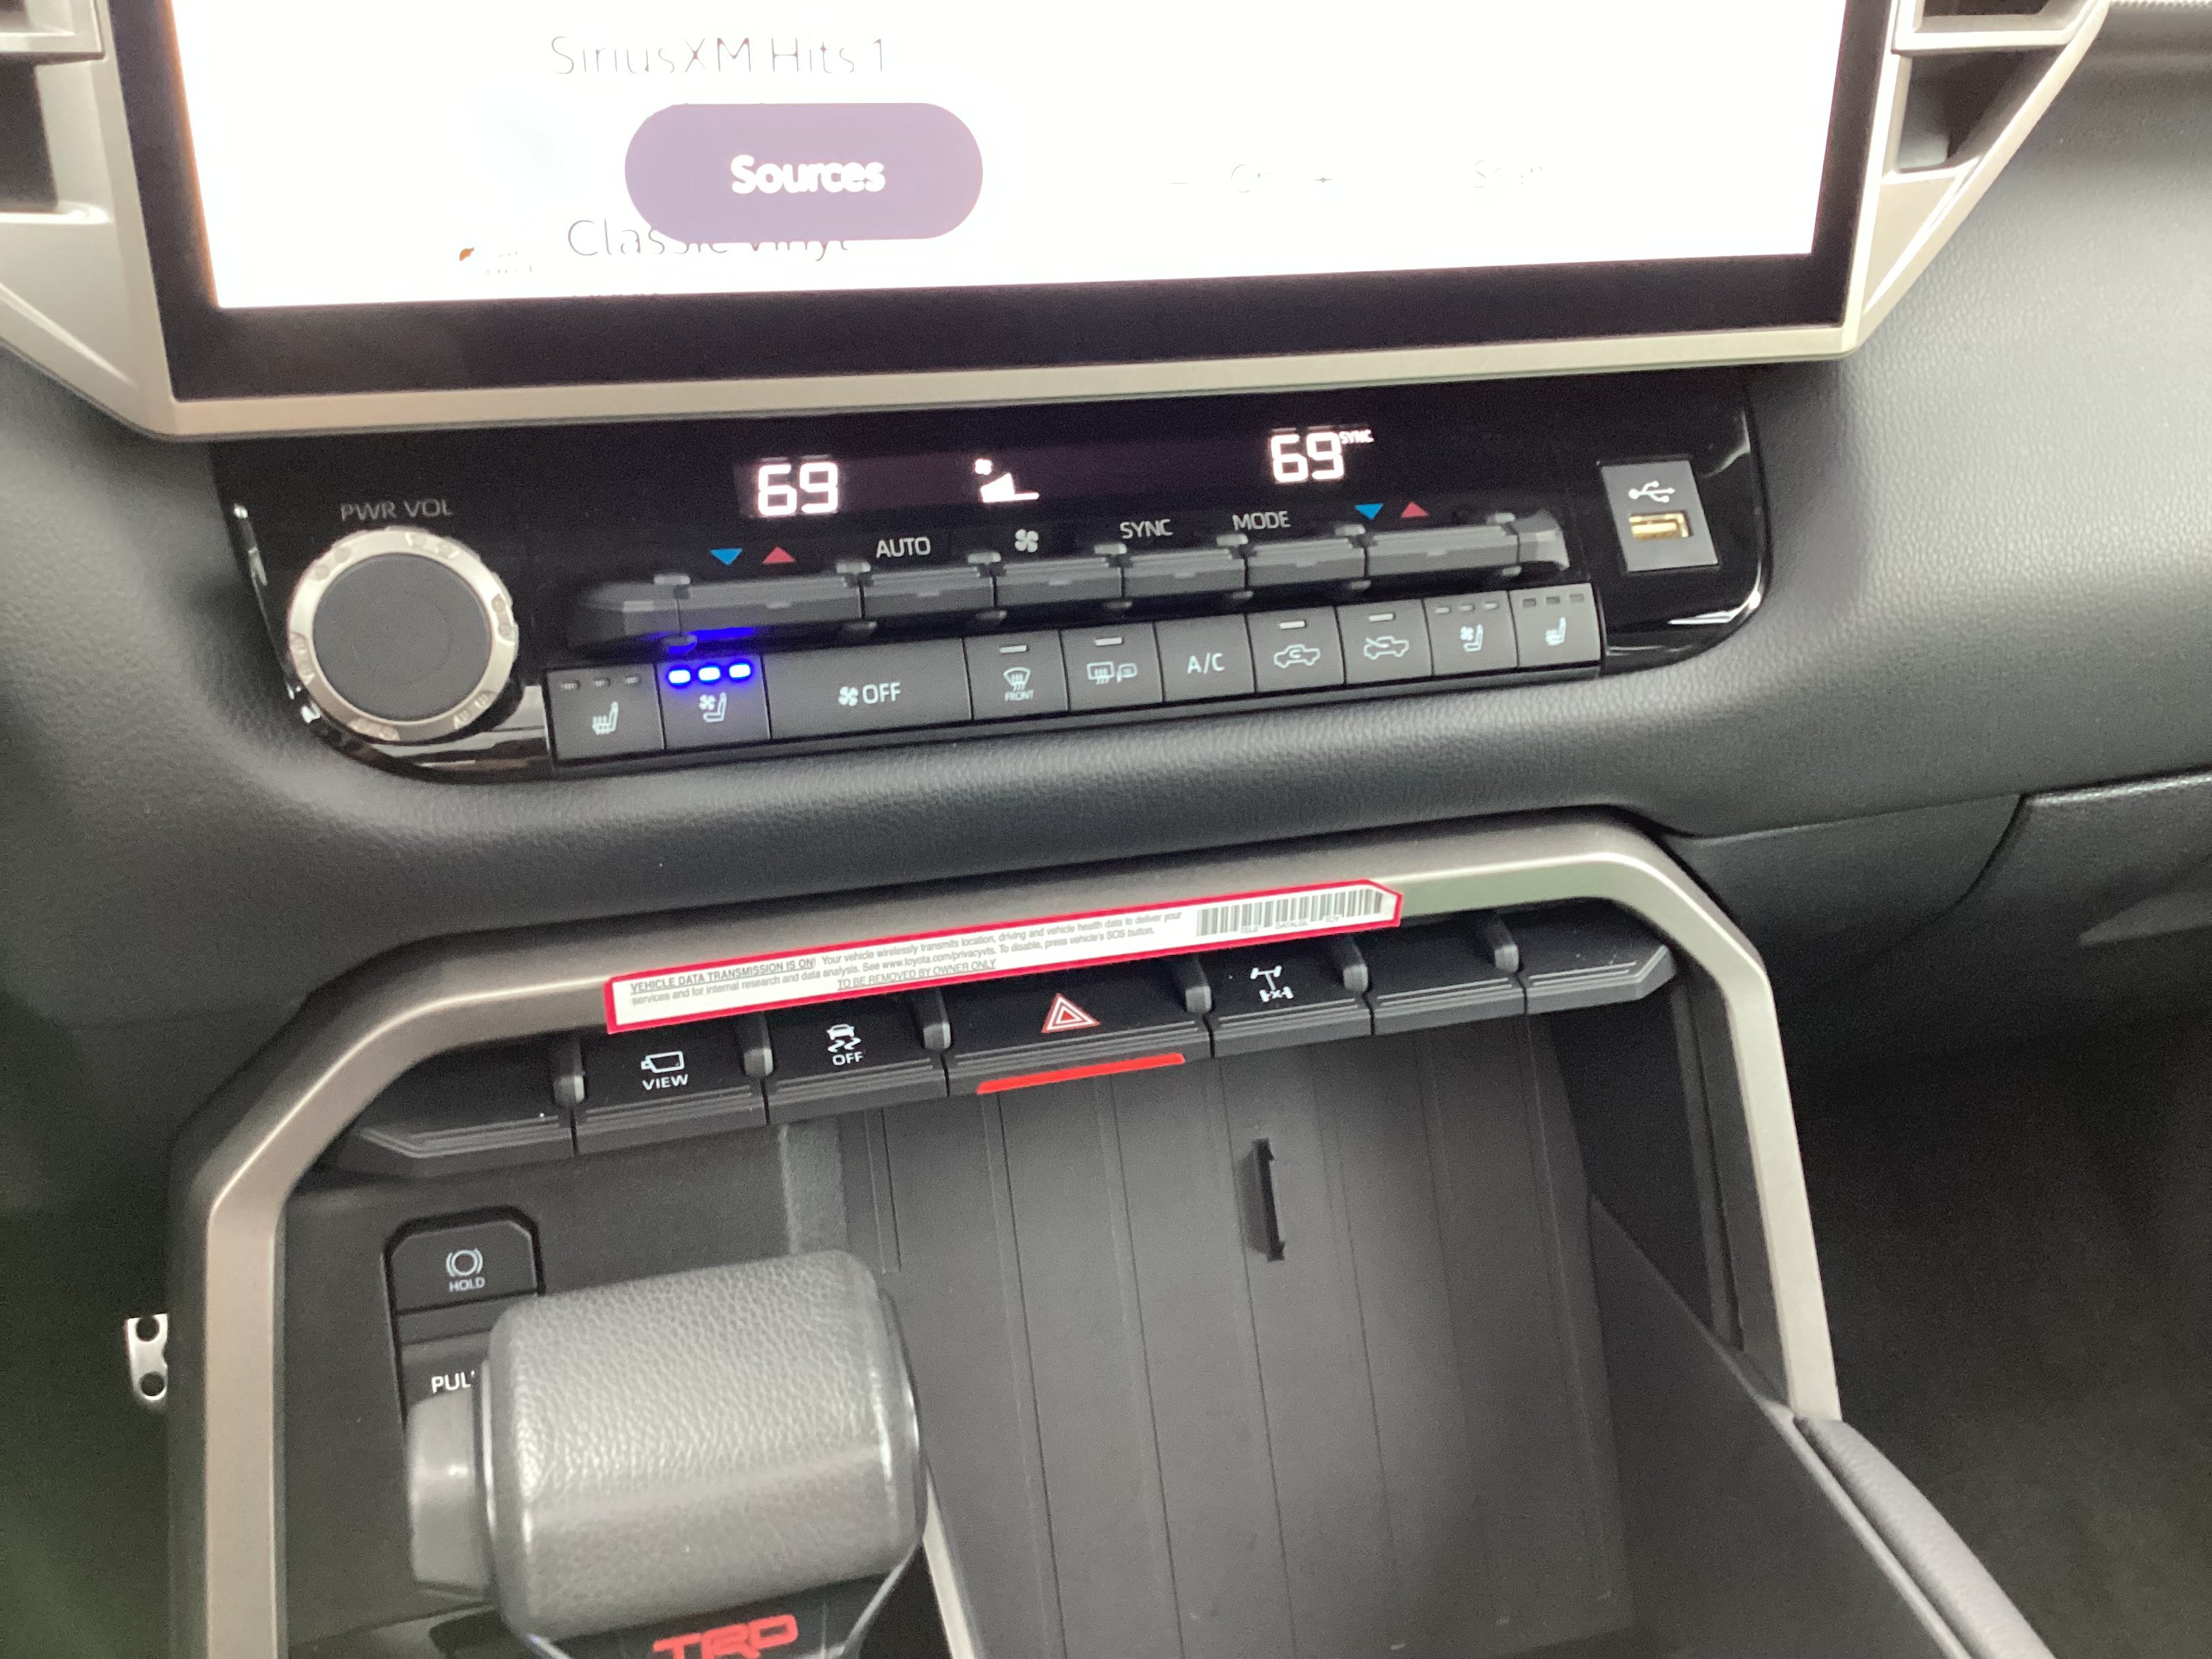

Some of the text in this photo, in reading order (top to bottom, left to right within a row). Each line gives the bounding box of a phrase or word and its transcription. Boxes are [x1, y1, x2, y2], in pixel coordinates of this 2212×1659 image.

[551, 36, 884, 75] SiriusXM Hits 1
[731, 154, 886, 195] Sources
[1270, 432, 1345, 483] 69
[757, 461, 840, 518] 69
[340, 498, 454, 522] PWR VOL
[1232, 510, 1291, 531] MODE
[1119, 518, 1173, 539] SYNC
[875, 536, 931, 559] AUTO
[1187, 653, 1225, 675] A/C
[862, 680, 901, 705] OFF
[1004, 689, 1035, 703] FRONT
[630, 977, 676, 990] VEHICLE
[678, 972, 705, 985] DATA
[707, 962, 784, 981] TRANSMISSION
[785, 960, 796, 971] IS
[821, 956, 841, 964] Your
[876, 945, 918, 957] wirelessly
[920, 940, 958, 951] transmits
[998, 931, 1025, 941] driving
[1029, 928, 1044, 937] and
[631, 990, 670, 1004] services
[672, 988, 689, 999] and
[691, 987, 703, 996] for
[706, 981, 739, 994] internal
[741, 975, 780, 988] research
[782, 972, 798, 983] and
[863, 962, 880, 971] See
[999, 944, 1008, 953] To
[837, 958, 996, 989] TO BE REMOVED BY OWNER ONLY
[832, 1050, 864, 1066] OFF
[642, 1074, 689, 1090] VIEW
[449, 1277, 486, 1292] HOLD
[431, 1370, 475, 1393] PUL
[652, 1614, 799, 1659] TRD
